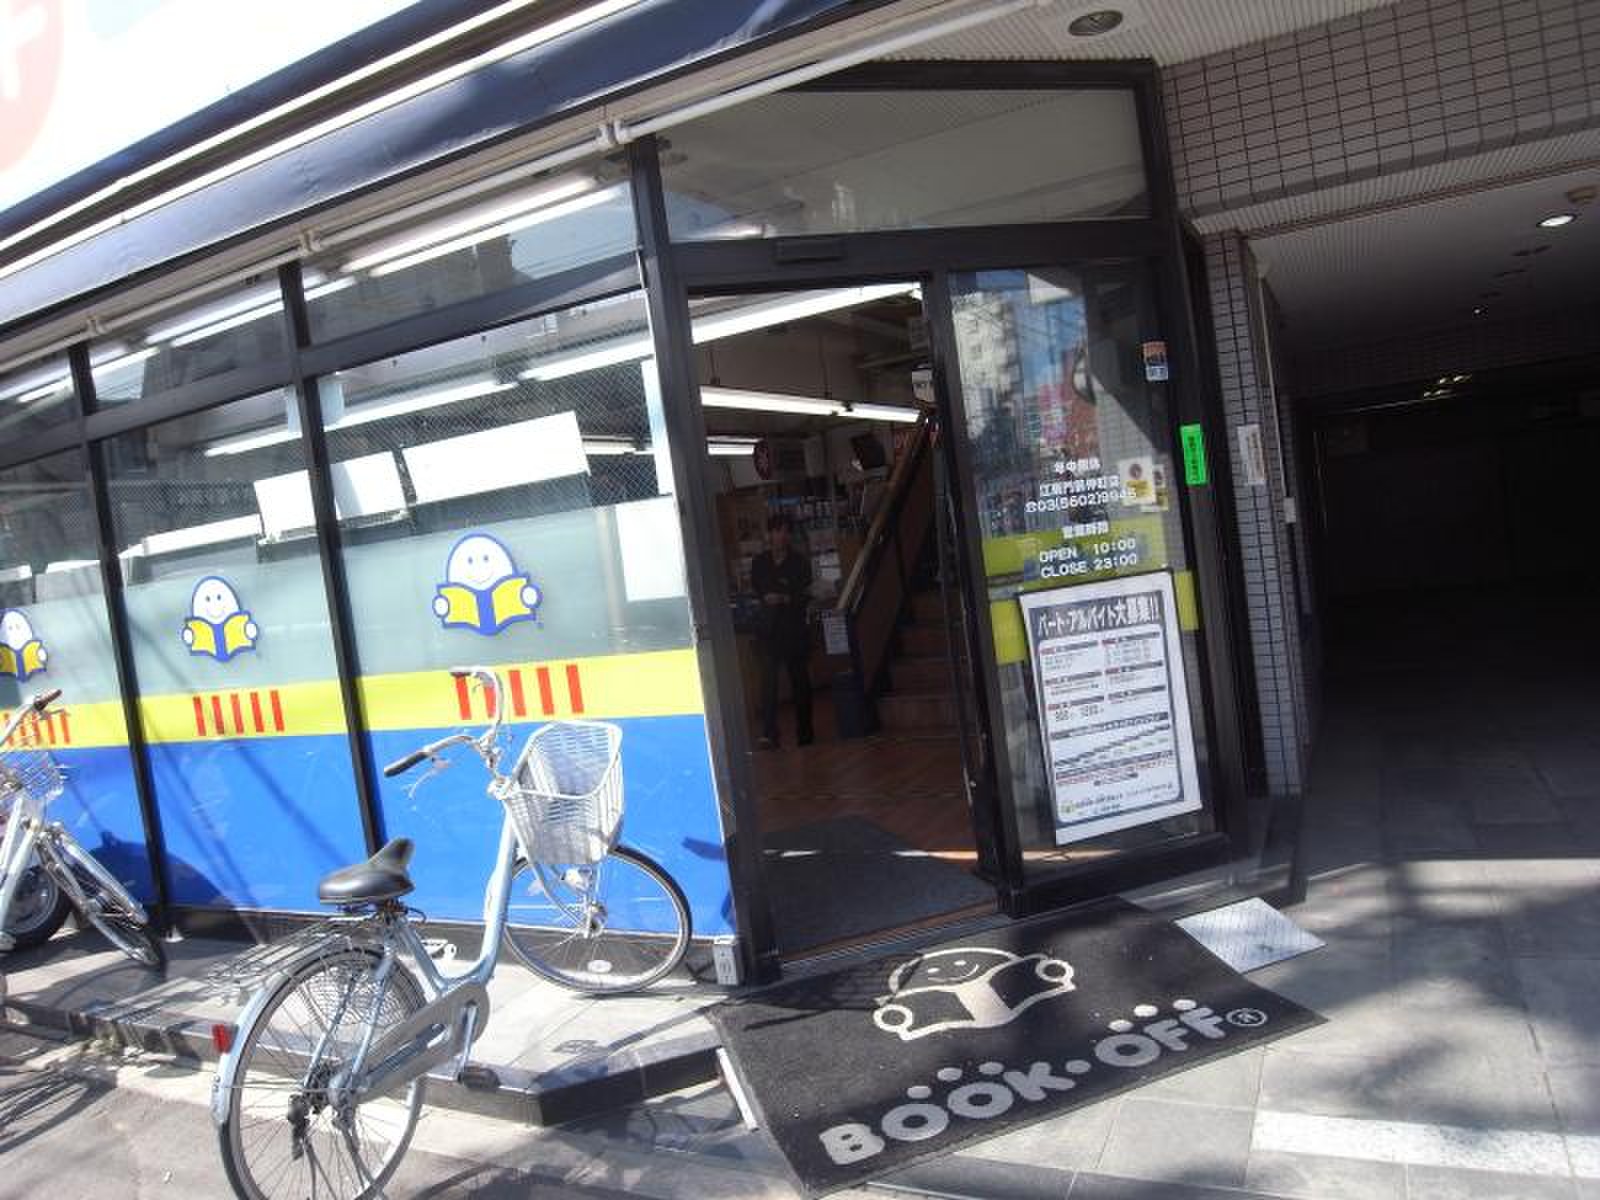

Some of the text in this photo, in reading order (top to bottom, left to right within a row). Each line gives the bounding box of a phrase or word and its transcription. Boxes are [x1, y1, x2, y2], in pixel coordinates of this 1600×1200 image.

[1039, 538, 1137, 563] OPEN 10:00
[1040, 553, 1137, 579] CLOSE 23:00
